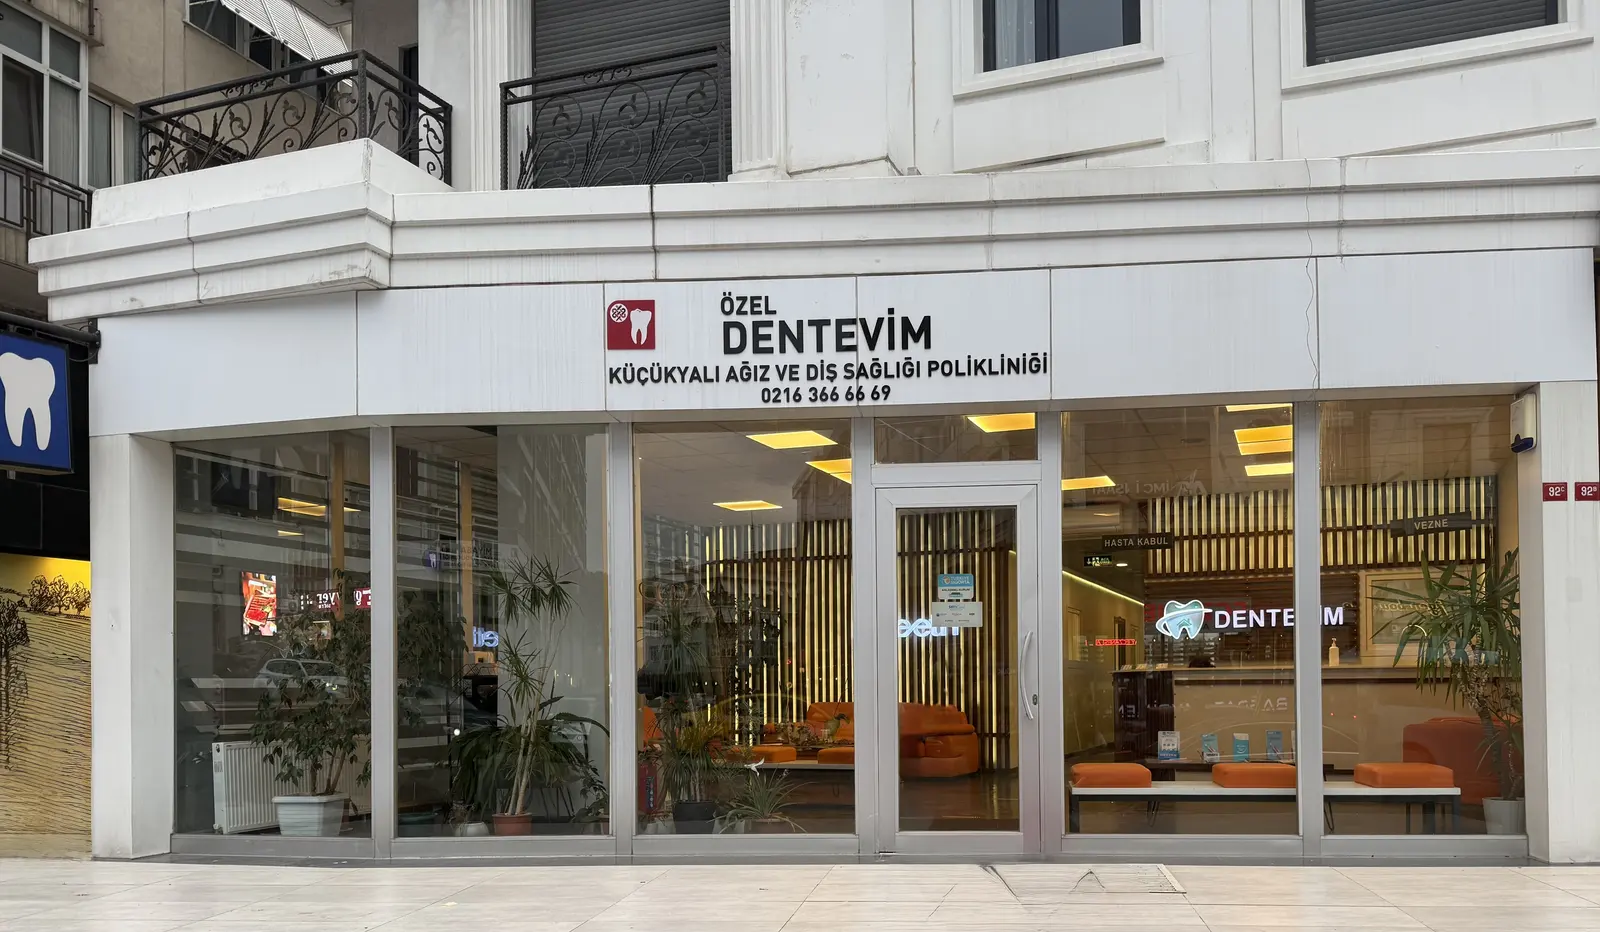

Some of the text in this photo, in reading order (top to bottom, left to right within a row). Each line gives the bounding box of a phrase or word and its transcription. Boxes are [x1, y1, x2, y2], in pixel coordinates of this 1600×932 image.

[720, 291, 777, 316] ÖZEL
[722, 307, 932, 355] DENTEVİM
[608, 352, 1048, 386] KÜÇÜKYALI AĞIZ VE DİŞ SAĞLIĞI POLİKLİNİĞİ
[761, 384, 891, 403] 0216 366 66 69
[1414, 518, 1449, 531] VEZNE
[1104, 537, 1169, 547] HASTA KABUL
[1214, 606, 1344, 629] DENTEM
